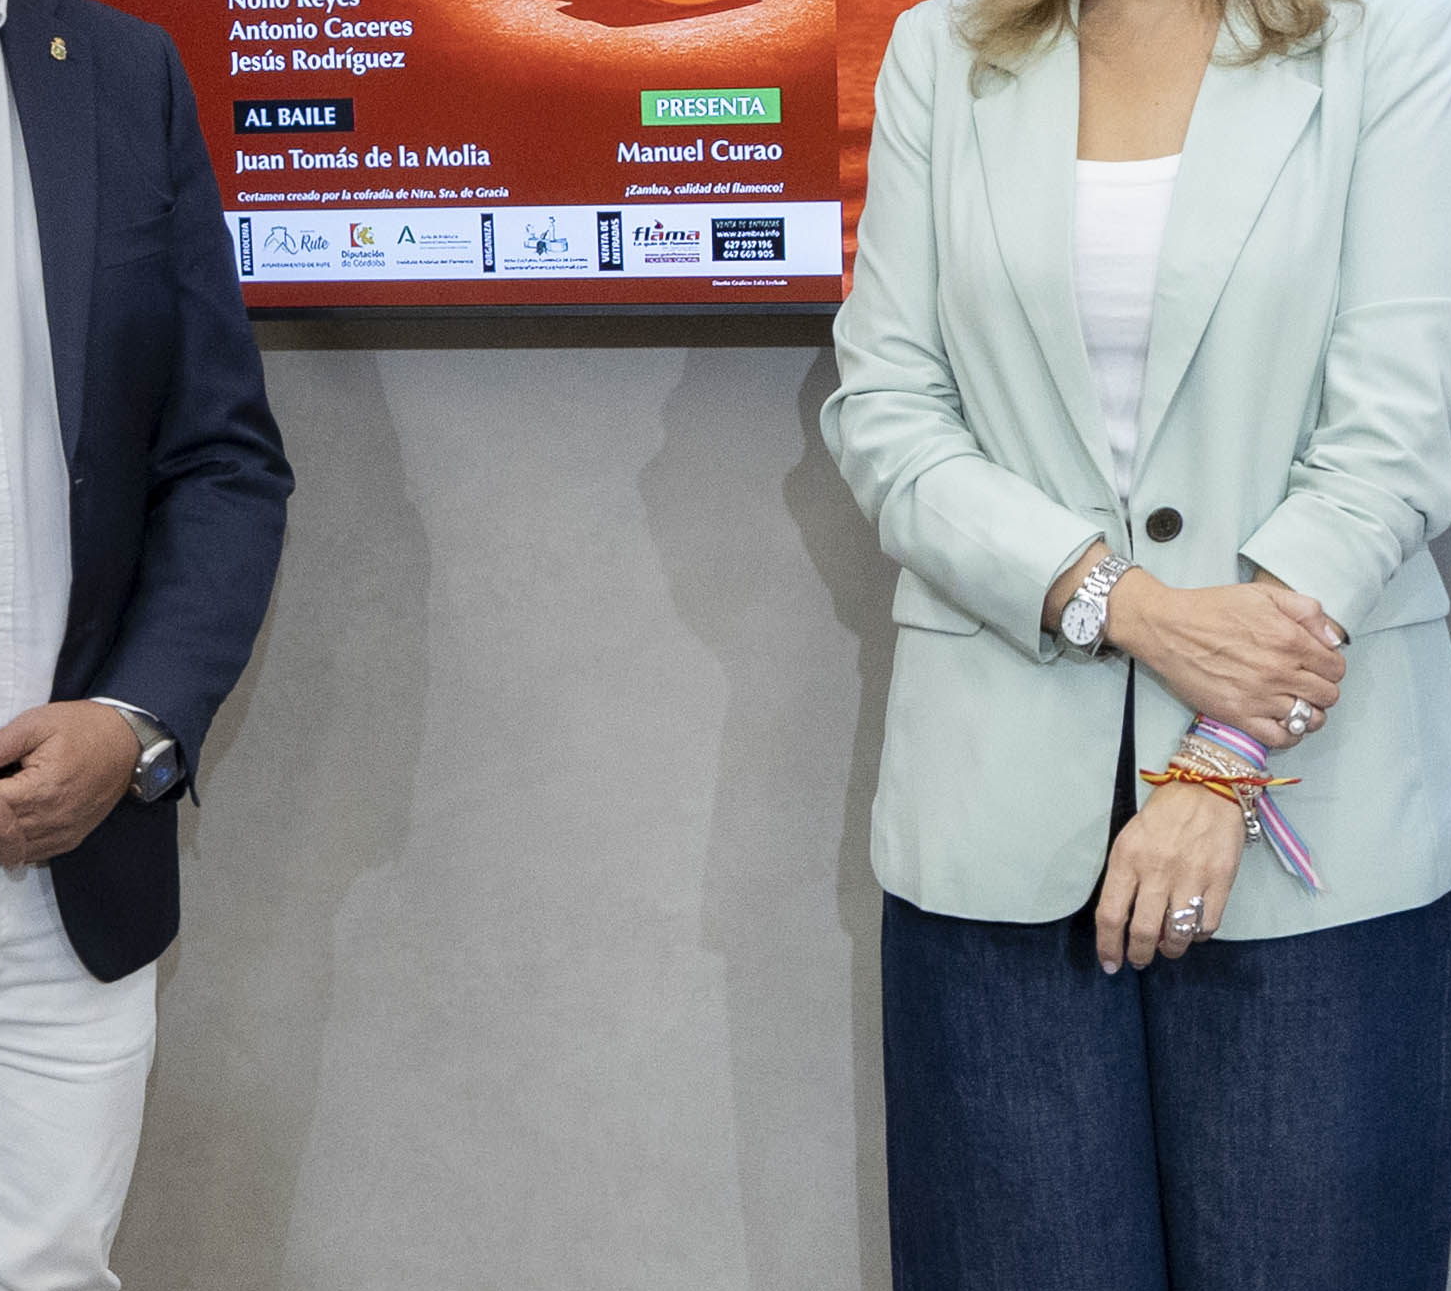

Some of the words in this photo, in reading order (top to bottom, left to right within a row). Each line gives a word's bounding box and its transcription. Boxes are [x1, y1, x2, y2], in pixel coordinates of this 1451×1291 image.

[229, 18, 318, 41] Antonio
[324, 18, 413, 38] Caceres
[230, 49, 286, 76] Jesús
[292, 47, 405, 76] Rodríguez
[245, 108, 271, 127] AL
[278, 107, 335, 126] BAILE
[656, 97, 766, 117] PRESENTA
[236, 151, 284, 174] Juan
[288, 147, 358, 171] Tomás
[364, 146, 392, 168] de
[399, 145, 419, 167] la
[426, 144, 491, 167] Molia
[617, 139, 704, 163] Manuel
[711, 140, 783, 161] Curao
[237, 191, 284, 202] Certamen
[287, 191, 319, 202] creado
[321, 191, 340, 203] por
[342, 189, 351, 201] la
[353, 188, 393, 201] cofradía
[395, 189, 409, 200] de
[411, 188, 436, 199] Ntra.
[439, 188, 458, 199] Sra.
[461, 188, 473, 198] de
[475, 187, 509, 198] Gracia
[625, 184, 671, 197] ¡Zambra,
[674, 183, 711, 195] calidad
[713, 183, 730, 194] del
[732, 182, 784, 194] flamenco!
[599, 220, 609, 231] DE
[632, 227, 700, 241] flama
[300, 235, 329, 252] Rute
[600, 233, 610, 263] VENTA
[610, 219, 621, 264] ENTRADAS
[724, 241, 740, 249] 627
[341, 250, 384, 259] Diputación
